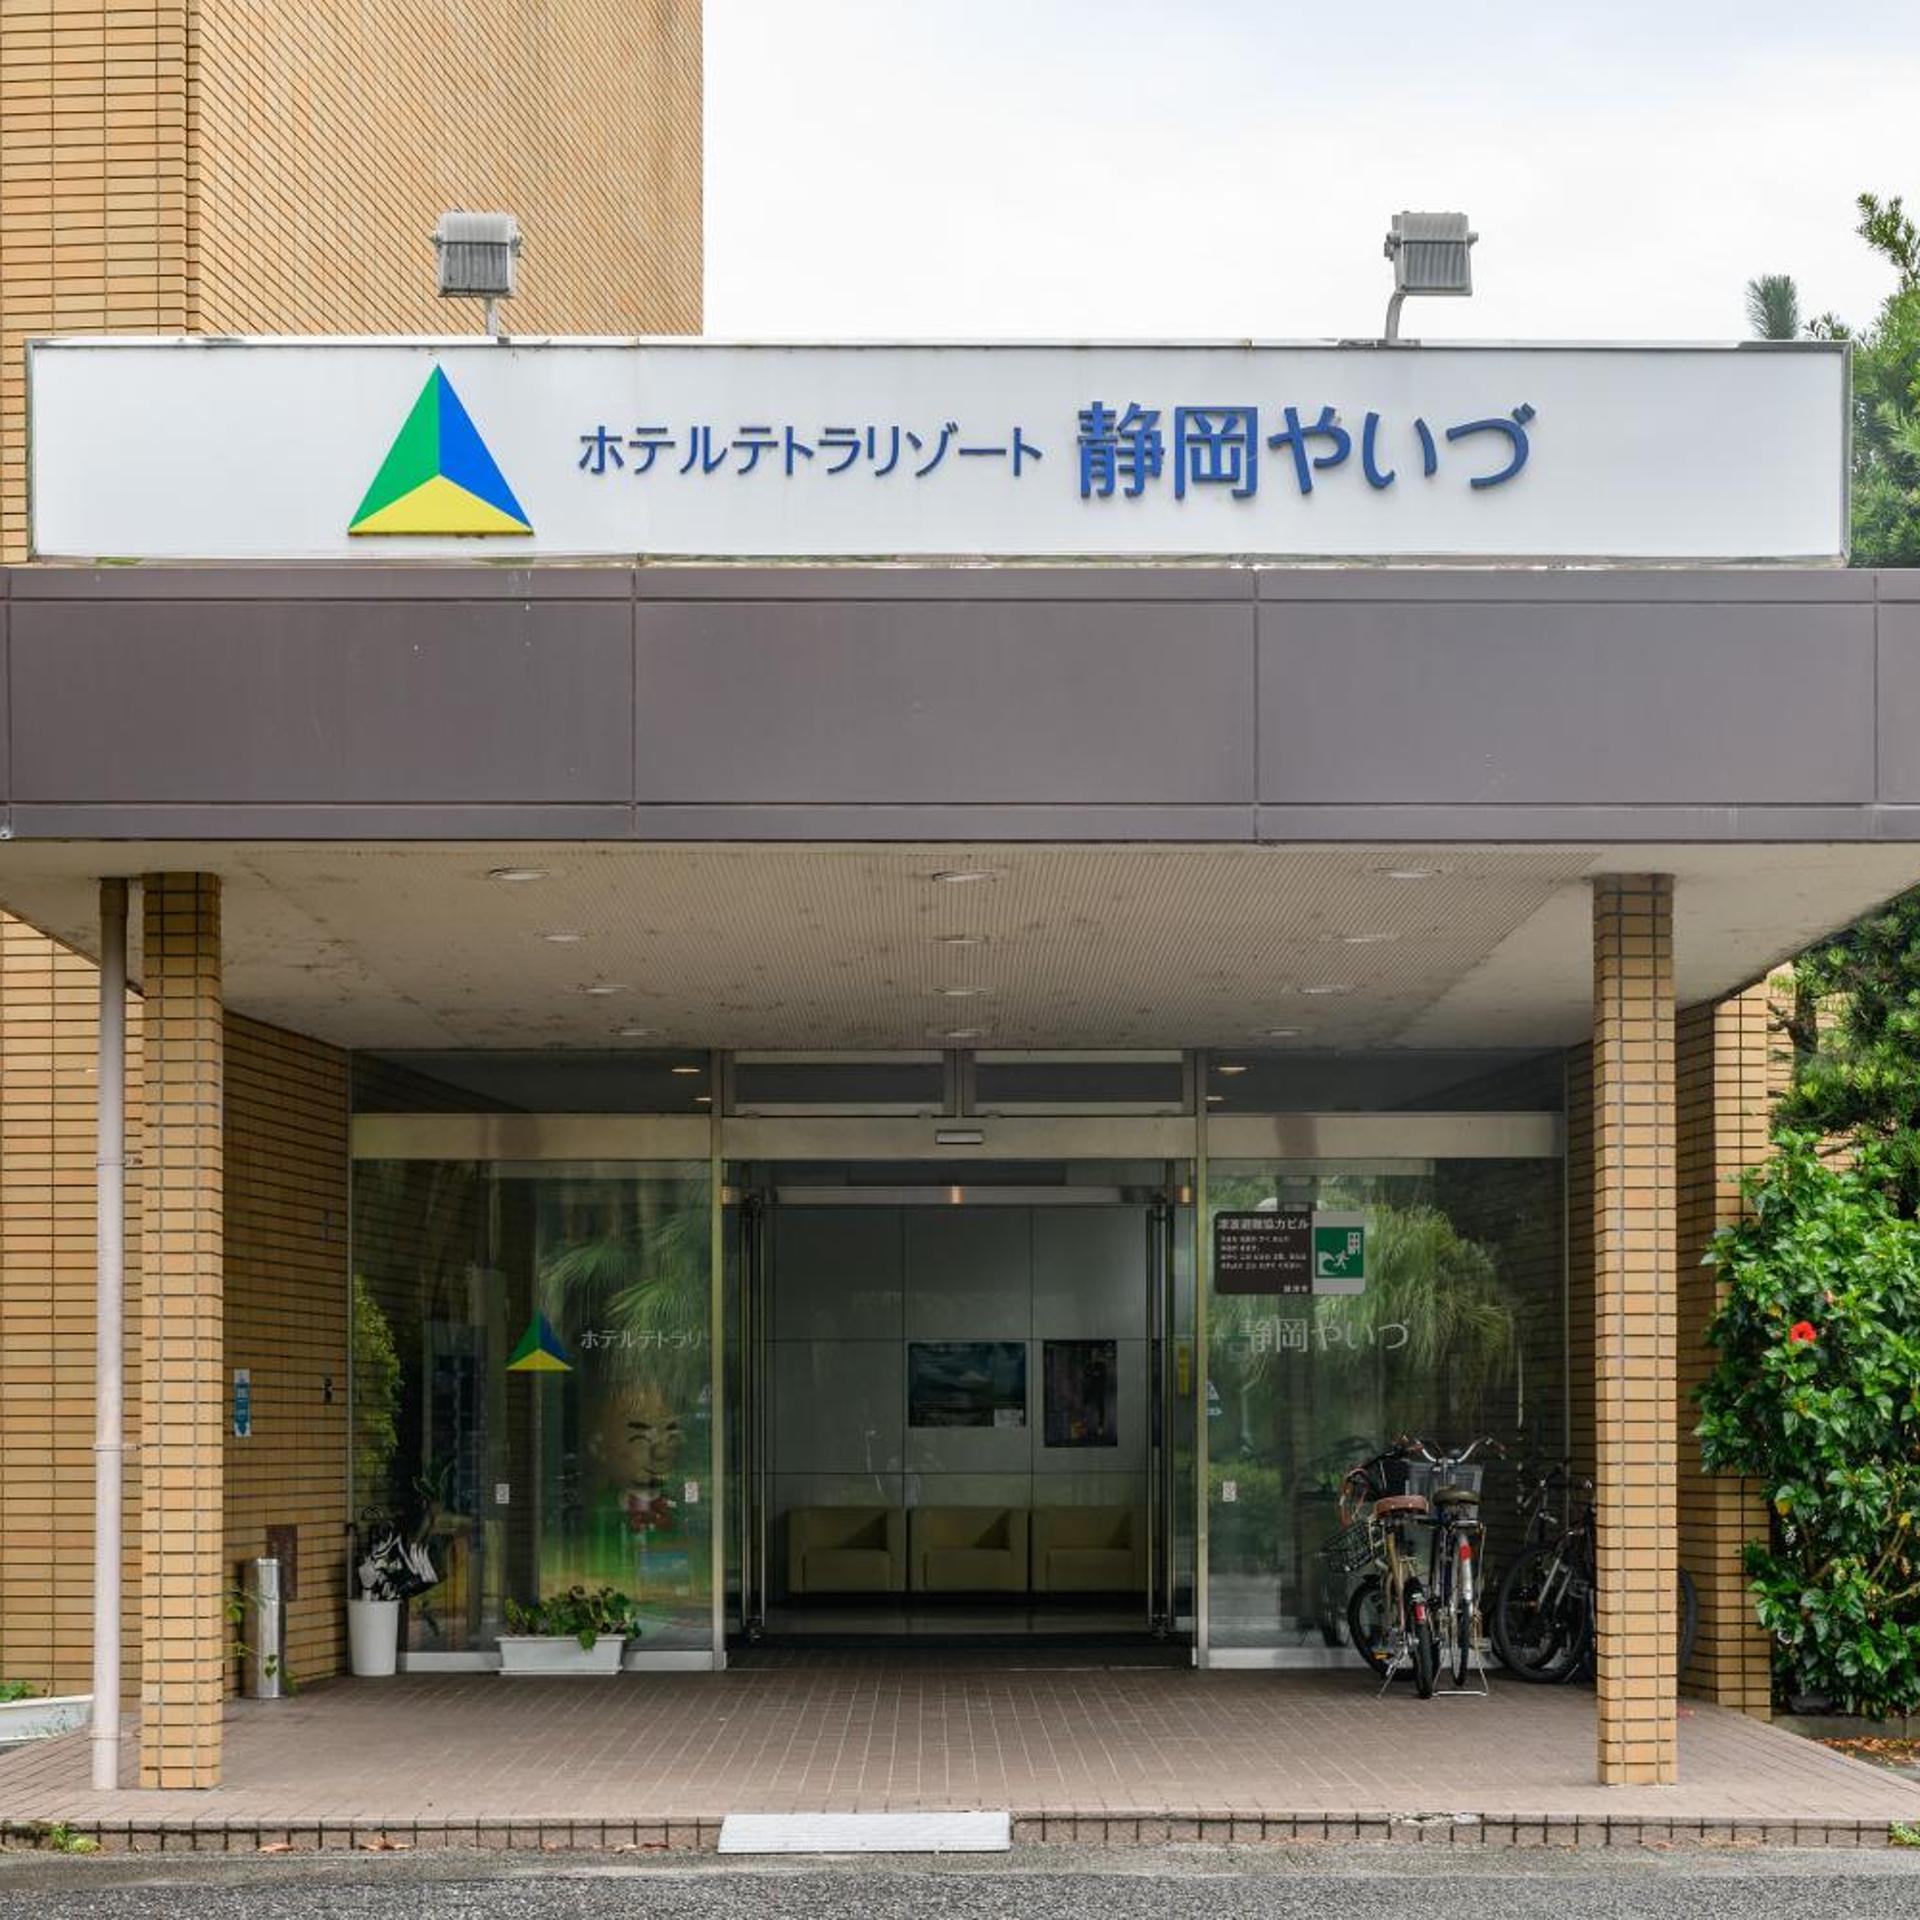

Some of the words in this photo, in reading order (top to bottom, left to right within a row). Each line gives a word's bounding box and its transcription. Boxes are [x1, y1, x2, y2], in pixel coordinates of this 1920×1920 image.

[579, 422, 1042, 477] ホテルテトラリゾート
[1077, 401, 1536, 500] 静岡やいづ
[1239, 1317, 1410, 1353] 静岡やいづ
